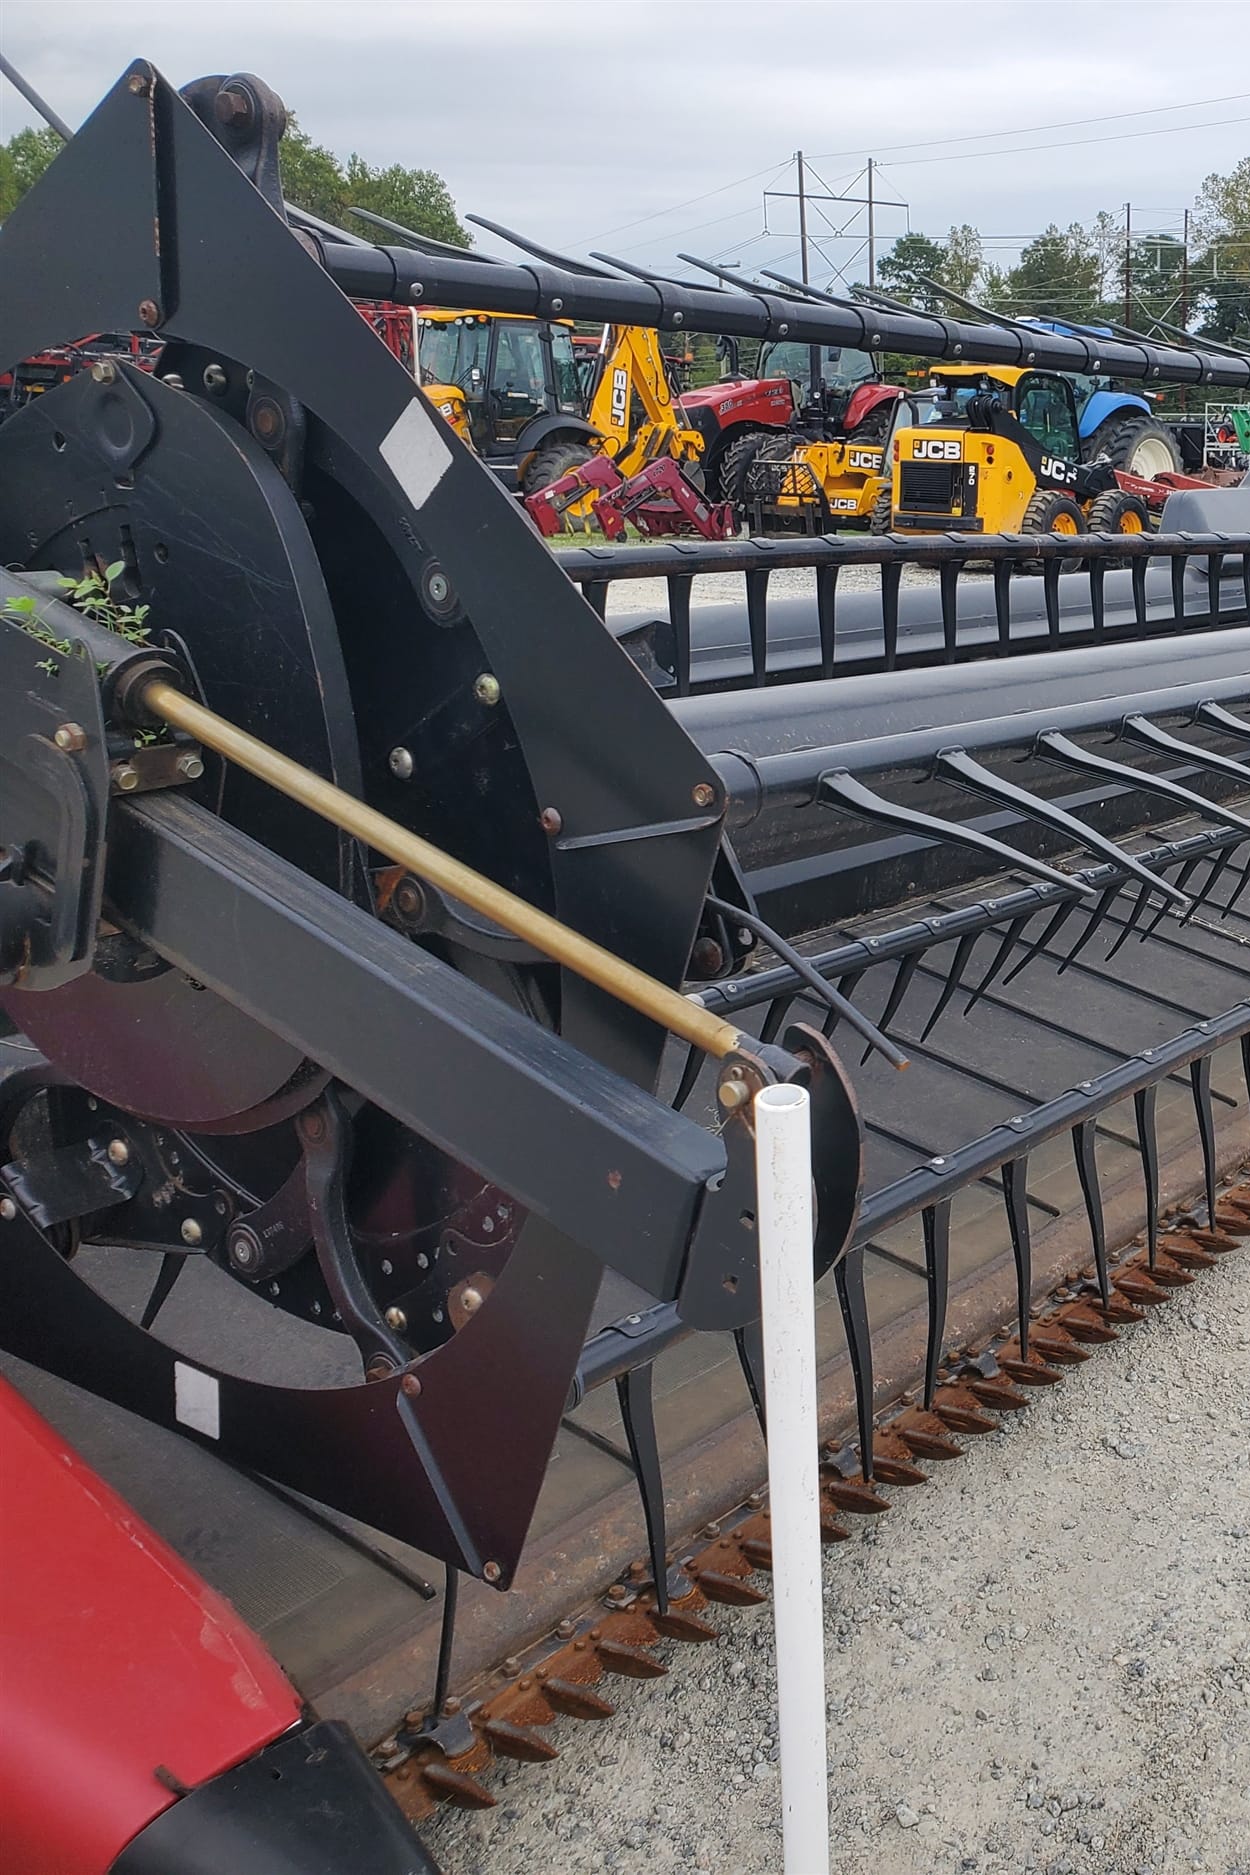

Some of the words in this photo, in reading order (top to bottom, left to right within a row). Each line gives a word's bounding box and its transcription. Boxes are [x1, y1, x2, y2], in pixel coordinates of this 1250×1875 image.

[612, 369, 627, 426] JCB
[914, 440, 961, 460] JCB
[968, 465, 976, 486] 270
[830, 498, 857, 510] JCB
